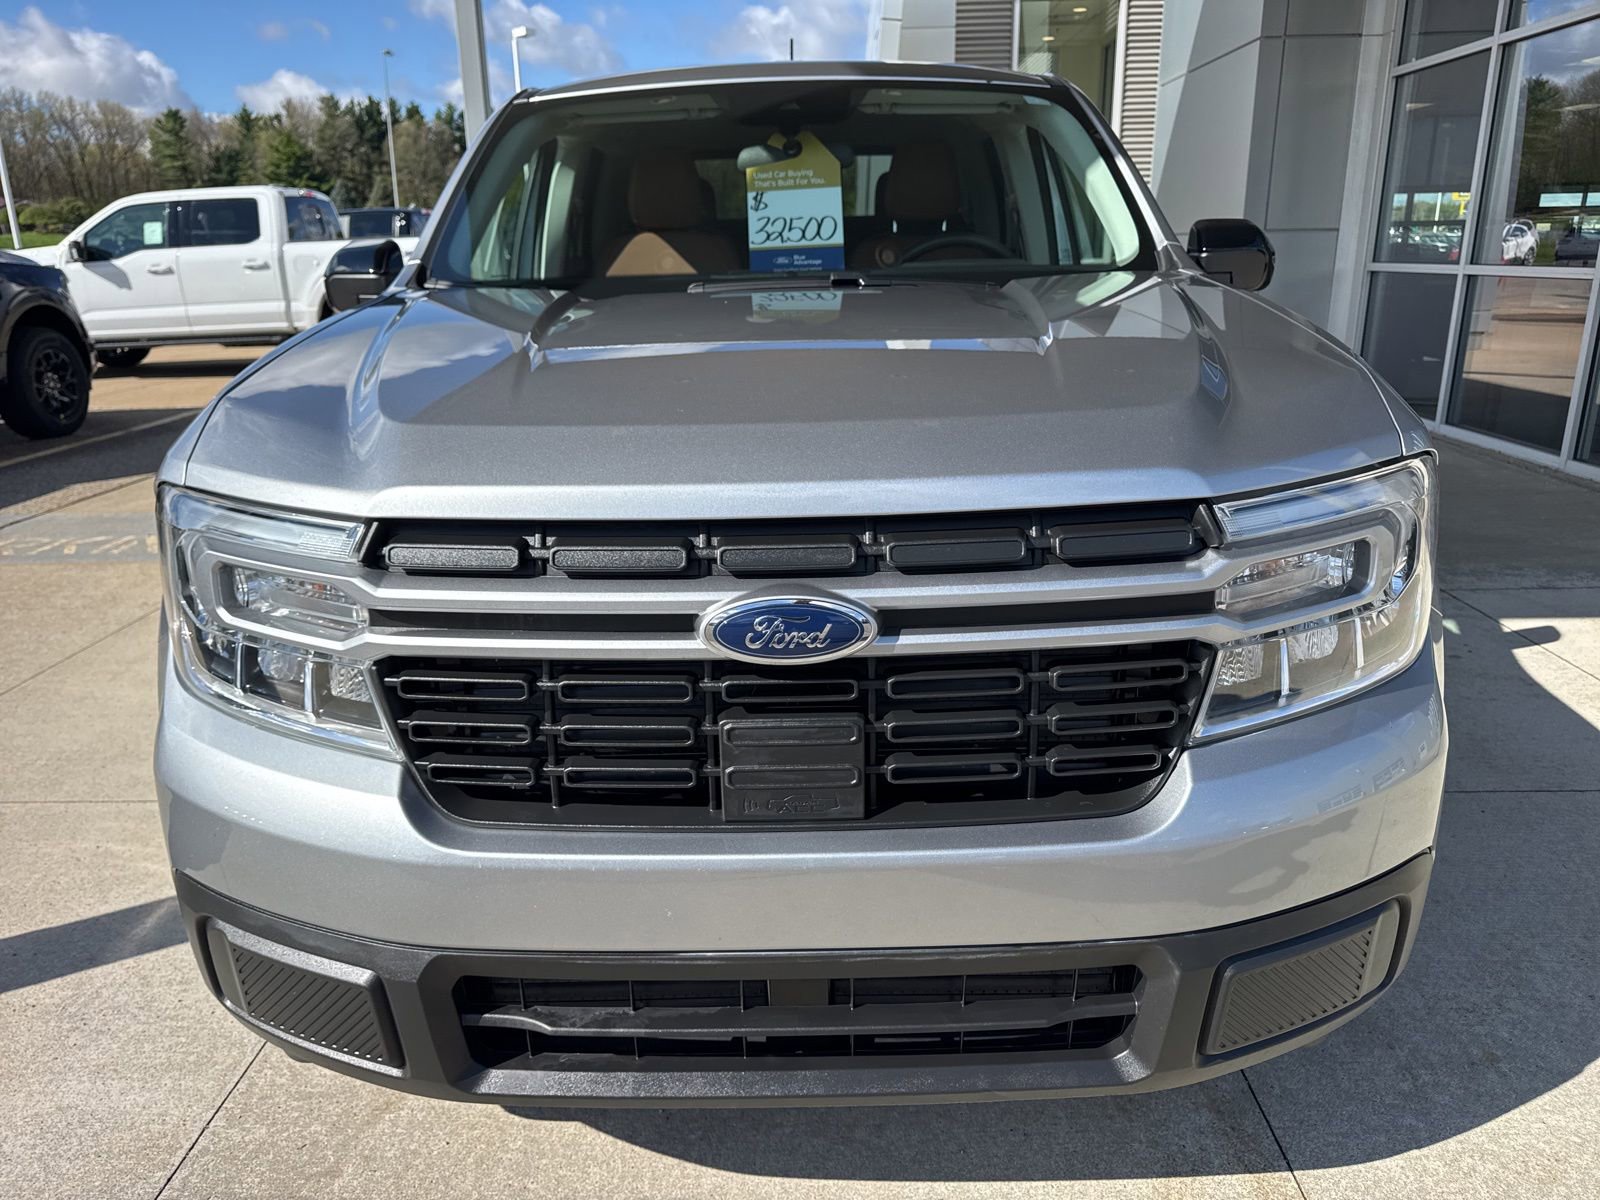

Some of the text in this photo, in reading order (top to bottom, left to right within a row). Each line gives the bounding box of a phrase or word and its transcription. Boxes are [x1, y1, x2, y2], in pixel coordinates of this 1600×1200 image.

[753, 168, 814, 179] Used Car Buying
[750, 192, 768, 212] $
[751, 216, 838, 245] 32500
[745, 615, 832, 649] Ford
